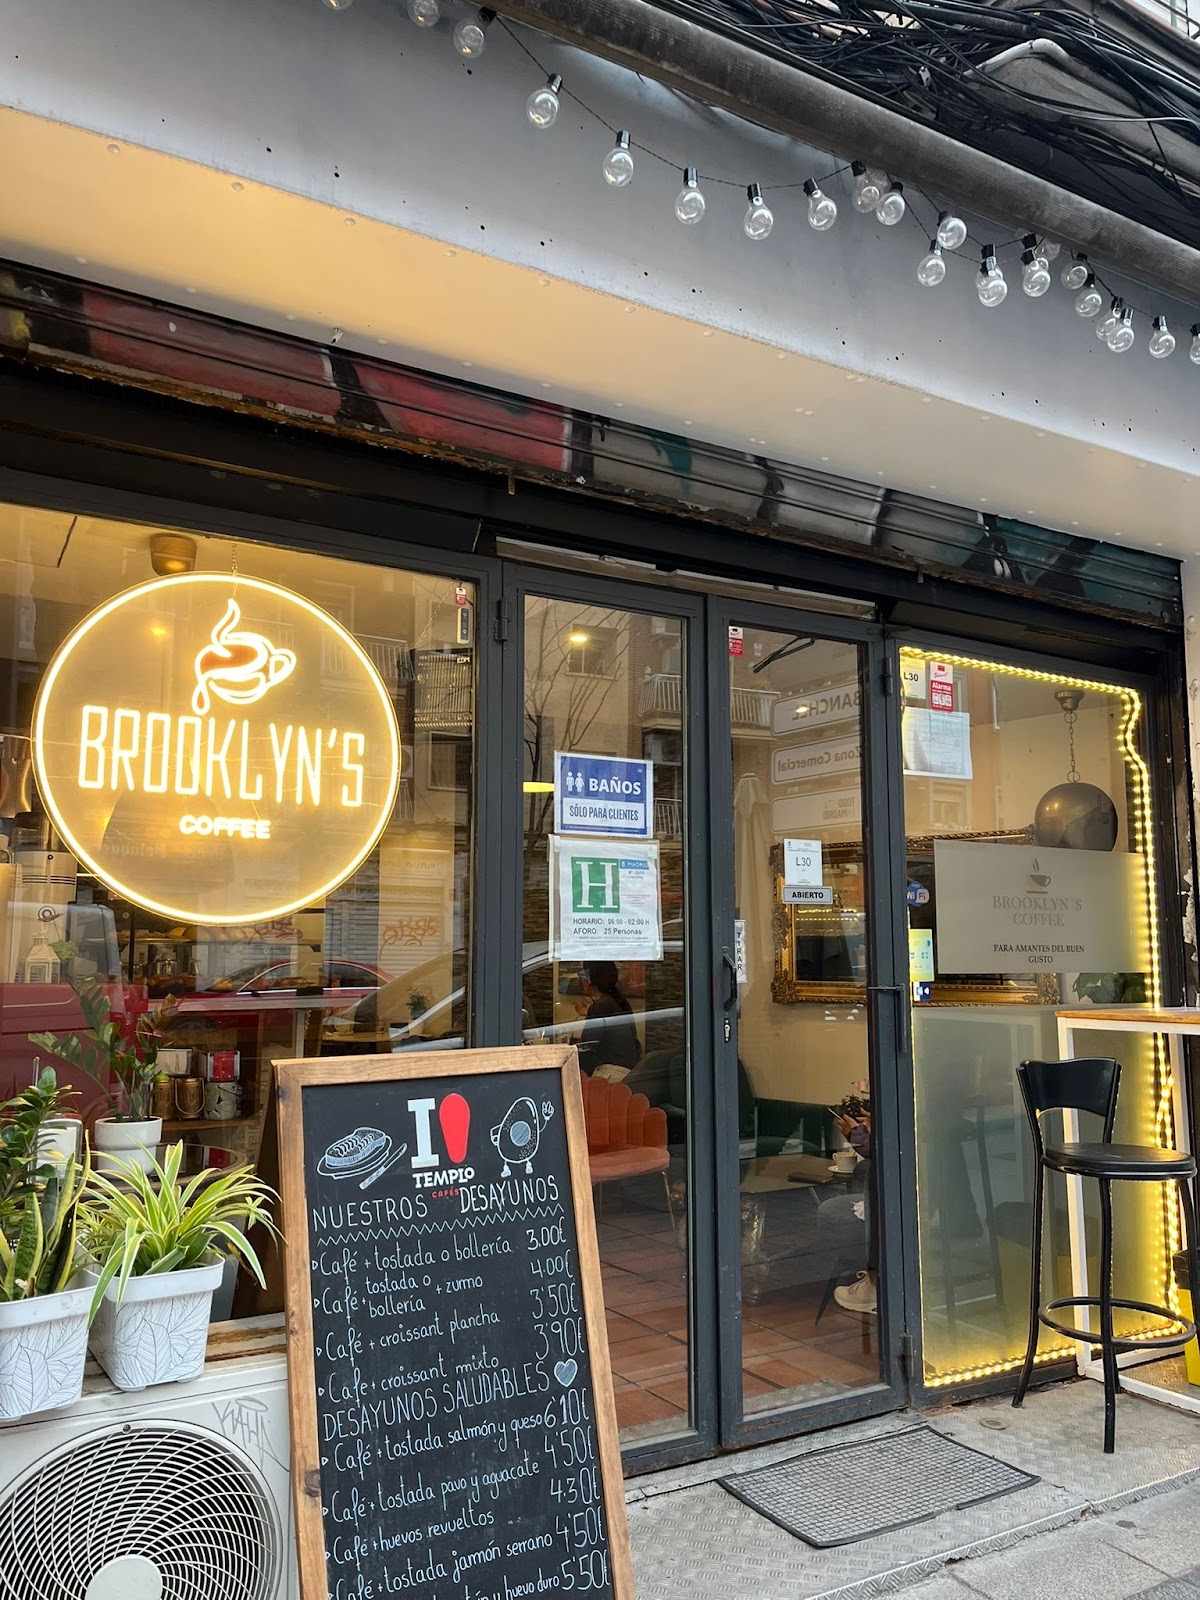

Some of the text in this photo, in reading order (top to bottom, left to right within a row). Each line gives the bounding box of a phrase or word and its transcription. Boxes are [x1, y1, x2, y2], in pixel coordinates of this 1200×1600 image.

[903, 672, 919, 682] L30
[932, 682, 952, 692] Alarma
[78, 705, 365, 807] BROOKLYN'S
[589, 776, 641, 795] BAÑOS
[178, 814, 271, 839] COFFEE
[569, 803, 639, 821] SÓLO PARA CLIENTES
[795, 856, 812, 867] L30
[576, 861, 618, 909] H
[792, 891, 824, 899] ABIERTO
[573, 917, 604, 925] HORARIO:
[627, 918, 645, 926] 02:00
[573, 927, 599, 935] AFORO:
[603, 927, 612, 935] 25
[1013, 913, 1065, 926] COFFEE
[993, 944, 1085, 953] PARA AMANTES DEL BUEN
[1028, 955, 1053, 964] GUSTO
[407, 1097, 440, 1169] I
[312, 1174, 559, 1232] NUESTROS DESAYUNOS
[431, 1186, 460, 1199] CAFÉS
[320, 1247, 358, 1285] Café
[364, 1259, 371, 1269] +
[374, 1239, 436, 1271] tostada
[441, 1249, 450, 1262] o
[453, 1232, 512, 1261] bollería
[365, 1270, 431, 1295] tostada o
[322, 1286, 359, 1325] Café
[369, 1294, 426, 1319] bollería
[436, 1284, 442, 1295] +
[446, 1275, 483, 1294] zumo
[325, 1327, 363, 1368] Café
[369, 1340, 376, 1350] +
[380, 1311, 444, 1347] croissant
[449, 1303, 500, 1345] plancha
[381, 1352, 448, 1391] croissant
[455, 1344, 499, 1374] mixto
[323, 1387, 438, 1441] DESAYUNOS
[442, 1360, 550, 1413] SALUDABLES
[334, 1438, 372, 1481] Café
[377, 1448, 383, 1458] +
[384, 1422, 444, 1460] tostada
[447, 1414, 496, 1444] salmón
[497, 1422, 507, 1452] y
[510, 1413, 543, 1449] queso
[332, 1487, 367, 1533] Café
[377, 1472, 436, 1511] tostada
[440, 1477, 467, 1512] pavo
[470, 1475, 480, 1503] y
[482, 1449, 540, 1500] aguacate
[333, 1535, 369, 1571] Café
[379, 1526, 423, 1551] huevos
[428, 1499, 495, 1537] revueltos
[336, 1574, 374, 1600] Café
[384, 1548, 448, 1593] tostada
[452, 1539, 501, 1583] jamón
[506, 1533, 553, 1557] serrano
[503, 1575, 535, 1600] huevo
[537, 1567, 560, 1593] duro
